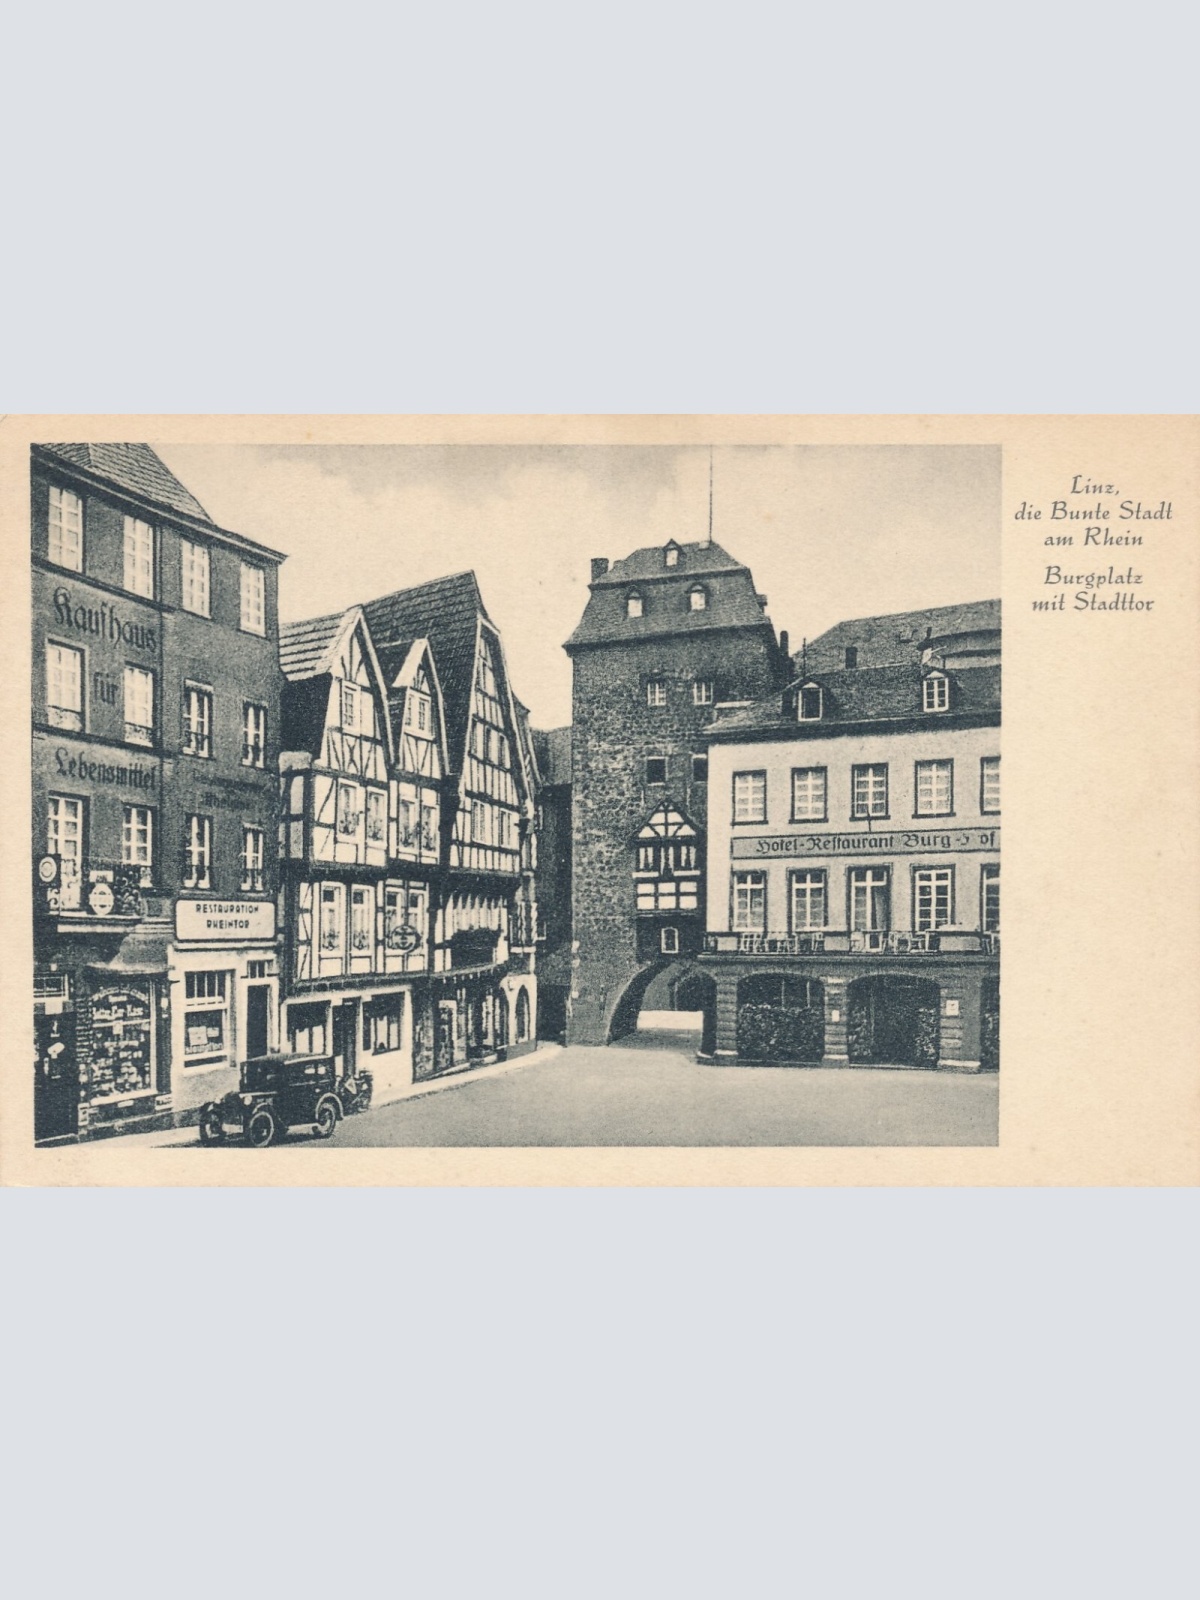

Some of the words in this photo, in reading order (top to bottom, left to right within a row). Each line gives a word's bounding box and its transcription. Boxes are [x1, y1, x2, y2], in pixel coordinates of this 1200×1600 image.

[54, 587, 157, 653] Kaufhaus
[93, 672, 119, 705] für
[55, 747, 158, 790] Lebensmittel
[196, 903, 259, 914] RESTAURATION
[207, 919, 250, 929] RHEINTOR
